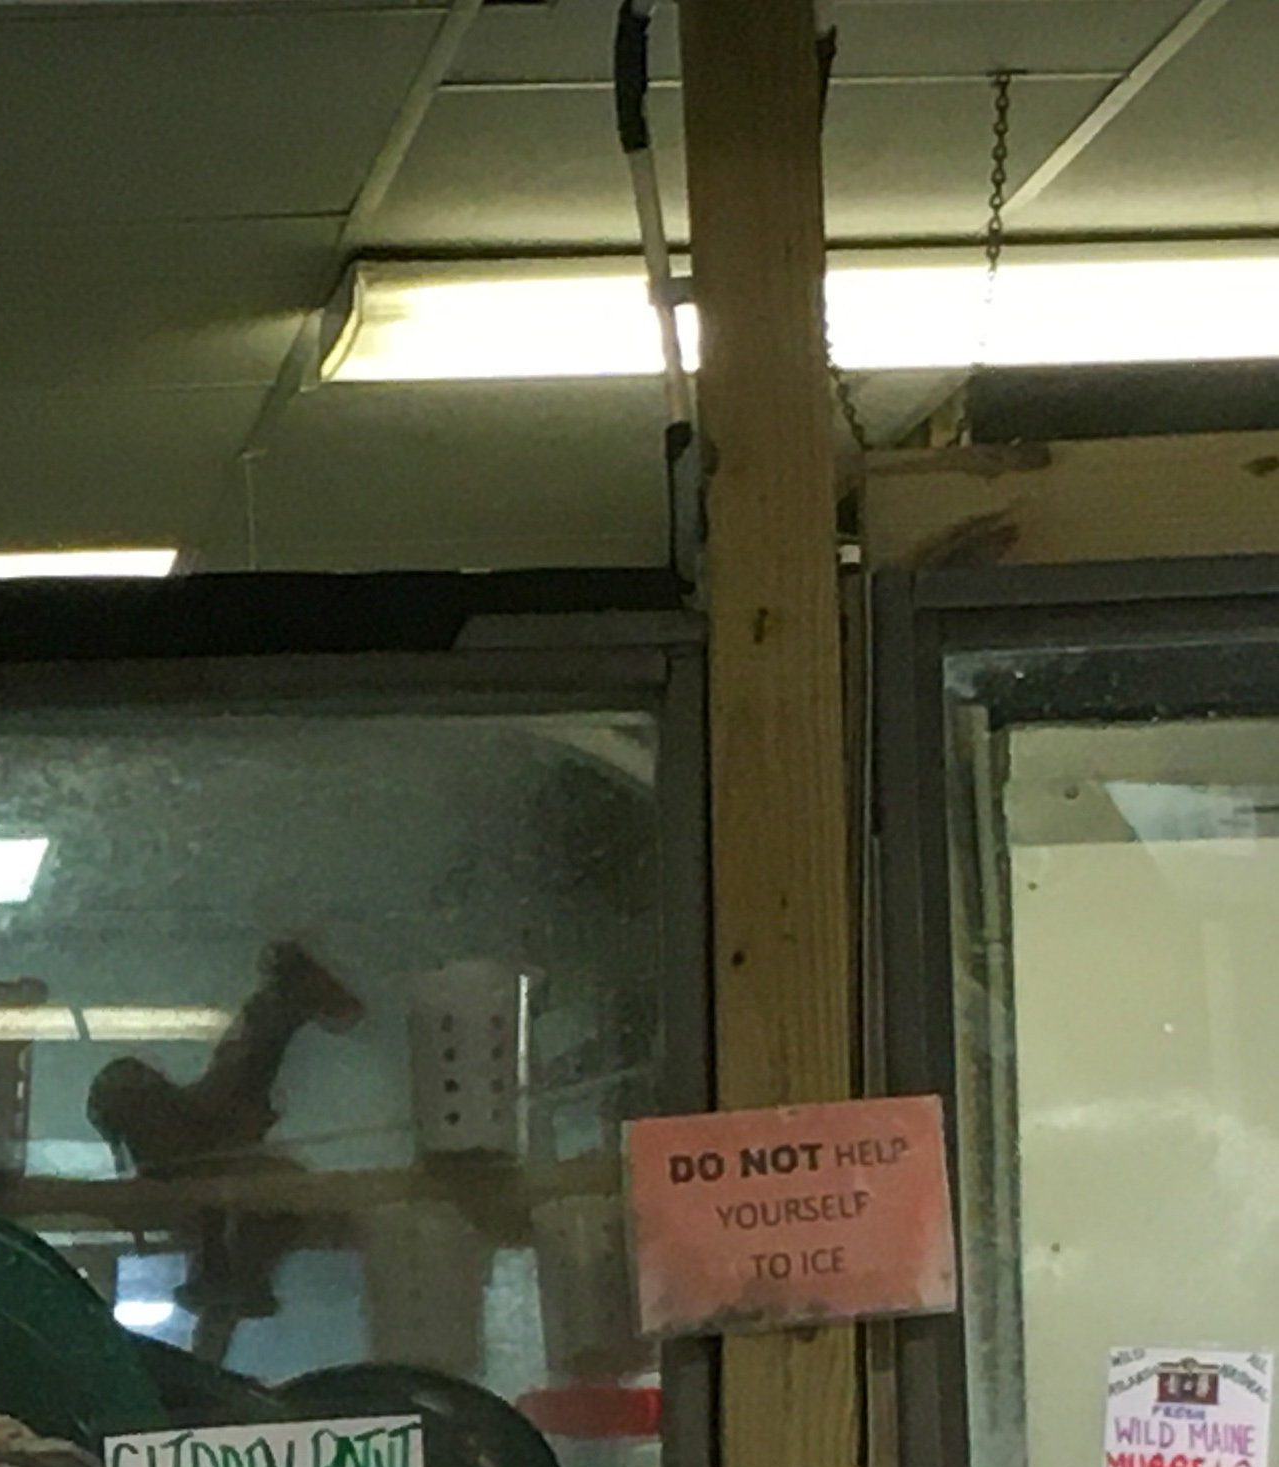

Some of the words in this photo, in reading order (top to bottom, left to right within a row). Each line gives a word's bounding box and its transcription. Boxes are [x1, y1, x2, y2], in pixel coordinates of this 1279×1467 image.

[669, 1152, 726, 1184] DO
[738, 1143, 824, 1178] NOT
[833, 1136, 909, 1168] HELP
[715, 1190, 871, 1229] YOURSELF
[749, 1252, 792, 1280] TO
[800, 1246, 845, 1275] ICE
[1114, 1416, 1175, 1448] WILD
[1189, 1422, 1256, 1457] MAINE
